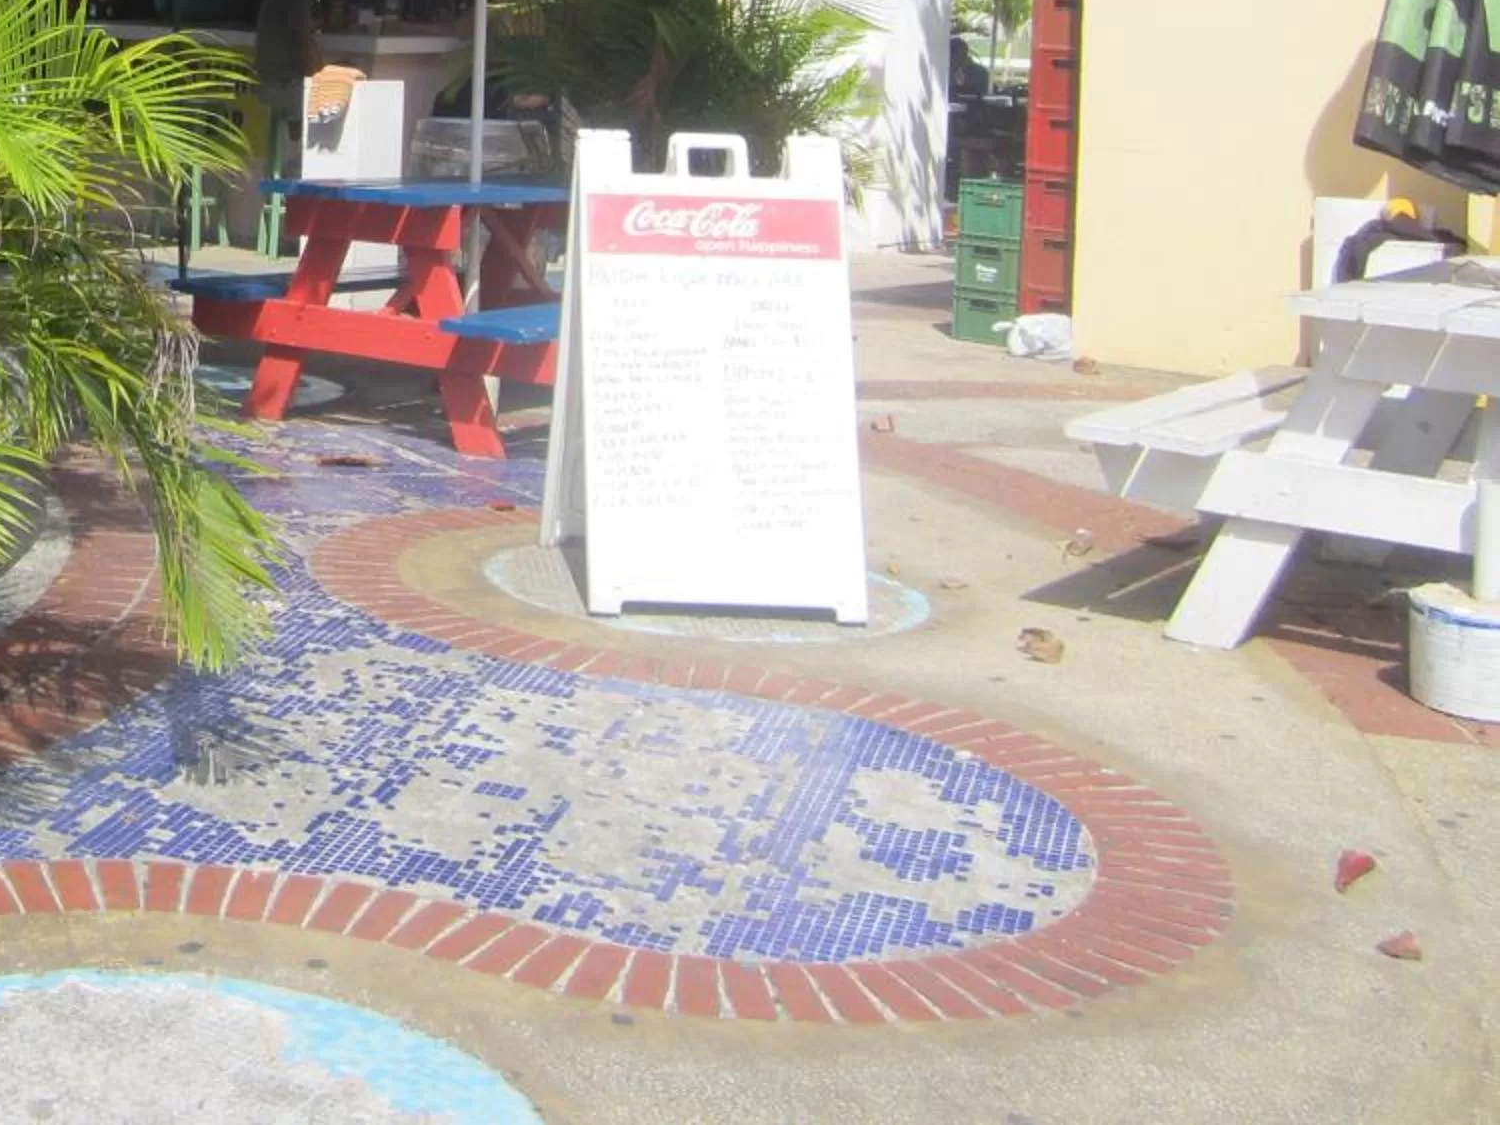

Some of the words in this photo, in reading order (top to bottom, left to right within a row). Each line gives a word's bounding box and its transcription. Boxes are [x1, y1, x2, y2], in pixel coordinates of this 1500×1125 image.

[623, 199, 763, 237] Coca-Cola
[694, 239, 733, 253] open
[738, 239, 820, 255] happiness
